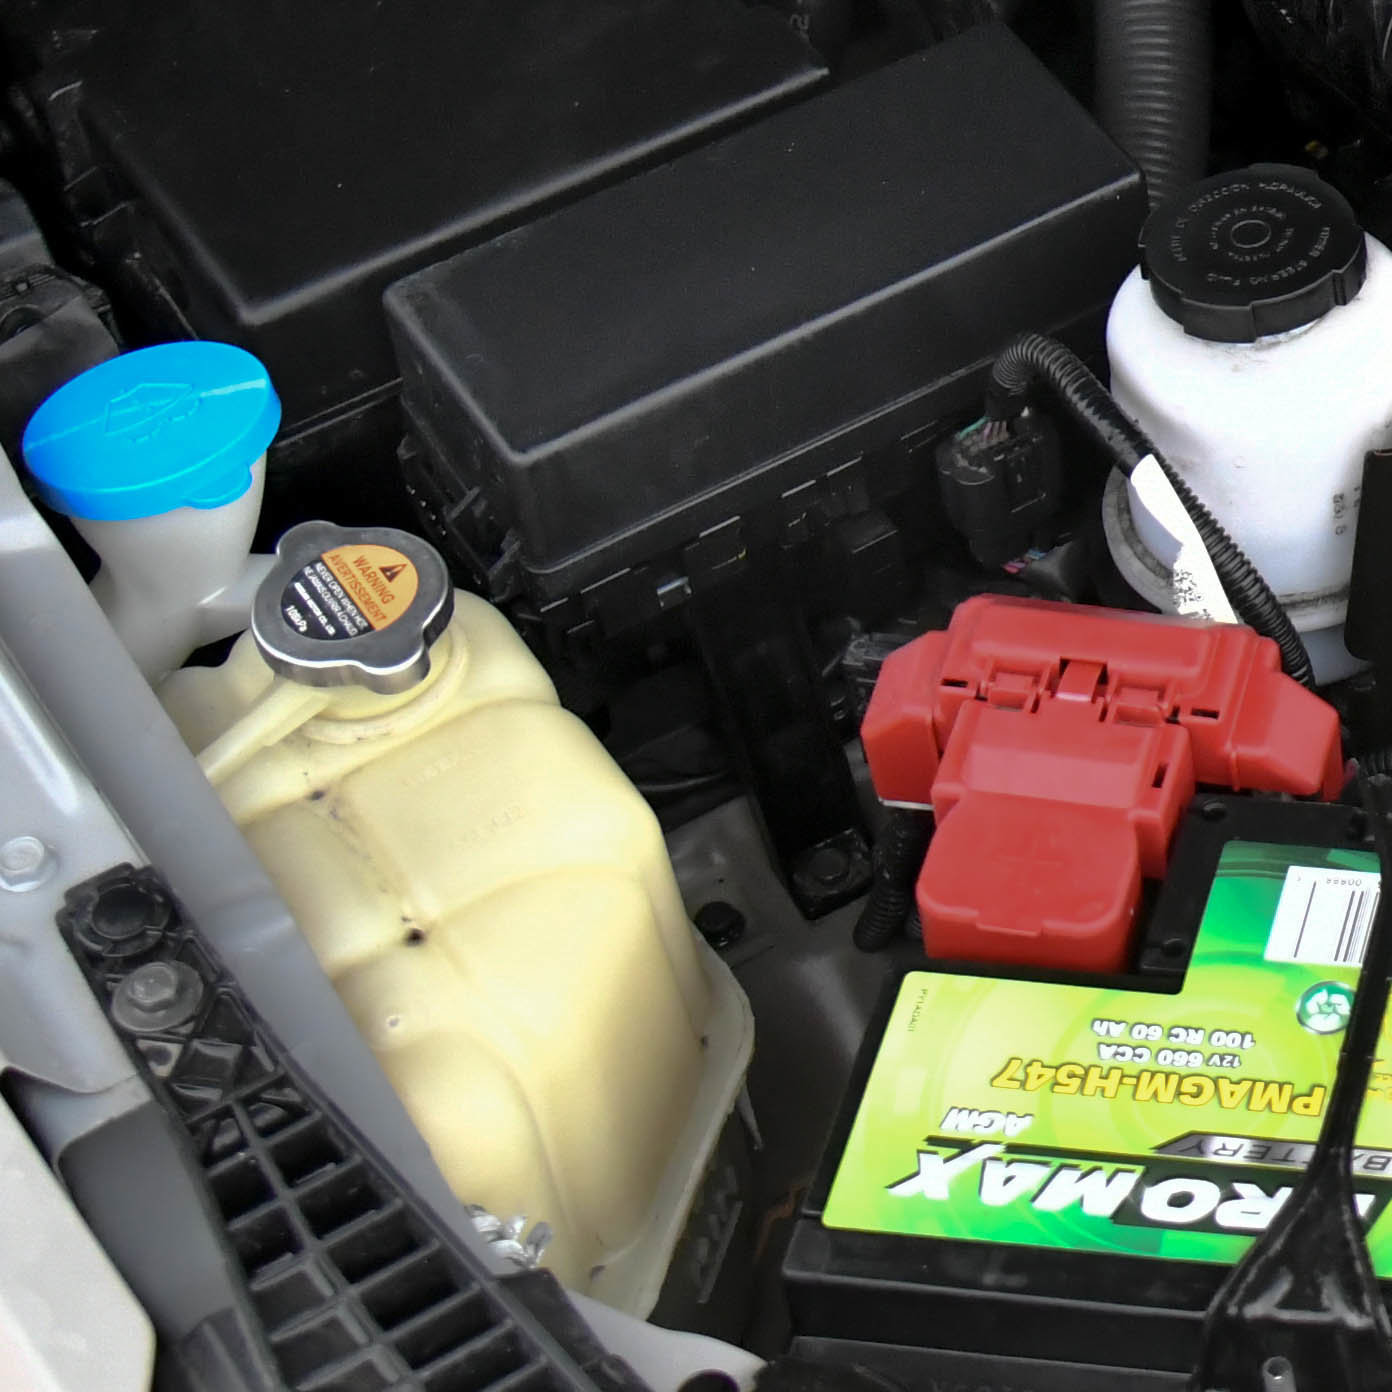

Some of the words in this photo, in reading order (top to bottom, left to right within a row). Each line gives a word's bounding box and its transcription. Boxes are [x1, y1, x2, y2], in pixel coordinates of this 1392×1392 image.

[313, 560, 334, 583] NEVER
[327, 579, 345, 599] OPEN
[339, 595, 359, 618] WHEN
[329, 553, 387, 623] AVERTISSEMENT
[352, 554, 396, 606] WARNING
[1090, 1018, 1128, 1041] Ah
[1130, 1022, 1163, 1043] 60
[1167, 1025, 1207, 1047] RC
[1210, 1028, 1257, 1051] 100
[1096, 1042, 1153, 1066] CCA
[1156, 1047, 1205, 1070] 660
[1208, 1051, 1241, 1070] 12V
[989, 1056, 1327, 1119] PMAGM-H547
[941, 1107, 1034, 1137] AGM
[1178, 1135, 1392, 1173] BTERY
[886, 1146, 1376, 1232] ROMAX
